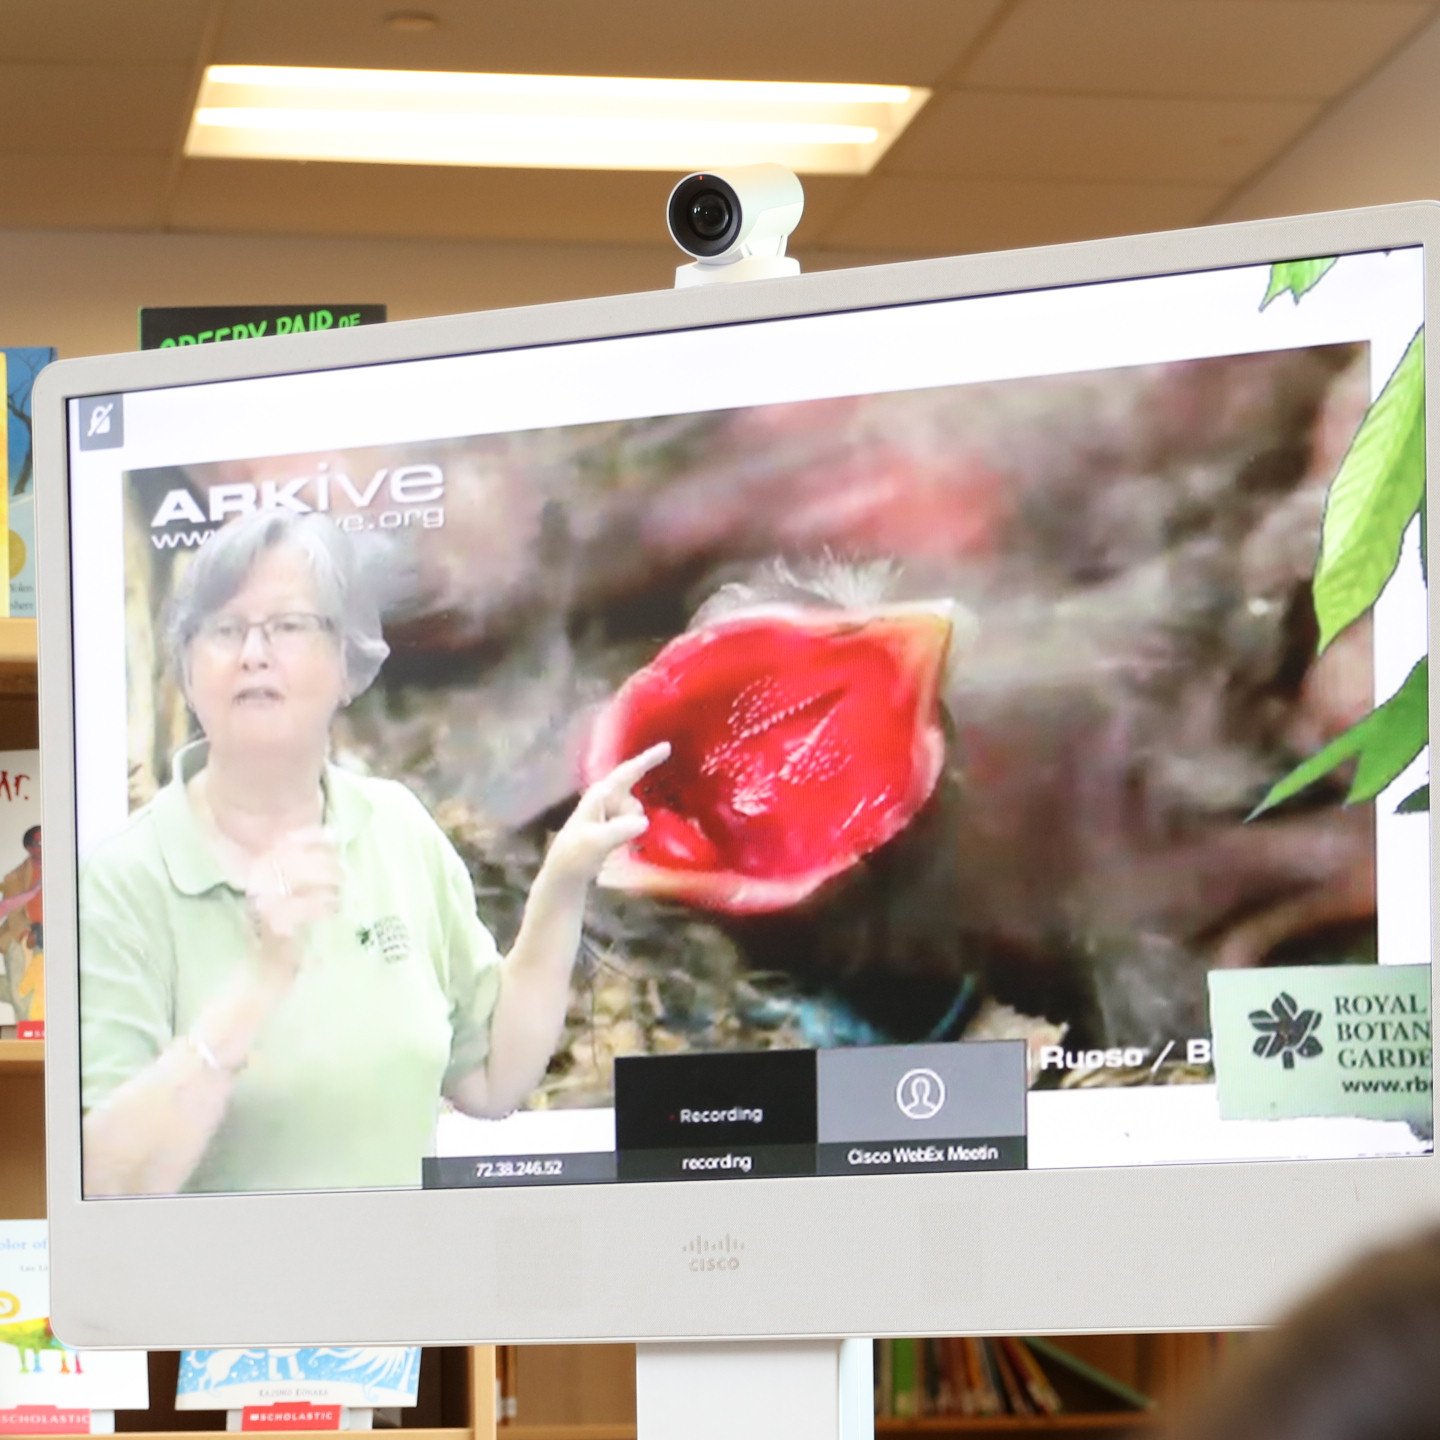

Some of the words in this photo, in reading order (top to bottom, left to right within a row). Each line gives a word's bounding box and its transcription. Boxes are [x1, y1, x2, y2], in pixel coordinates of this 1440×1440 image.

[1335, 994, 1427, 1015] ROYAL
[1337, 1021, 1432, 1042] BOTAN
[1040, 1045, 1145, 1071] Ruoso
[1338, 1048, 1432, 1069] GARDE
[1342, 1076, 1433, 1093] www.rb
[680, 1107, 764, 1124] Recording
[682, 1154, 753, 1172] recording
[847, 1148, 891, 1165] Cisco
[893, 1146, 945, 1163] WebEx
[33, 1238, 47, 1251] of
[688, 1257, 740, 1272] CISCO
[2, 1414, 90, 1425] SCHOLASTIC
[260, 1412, 334, 1422] SCHOLASTIC
